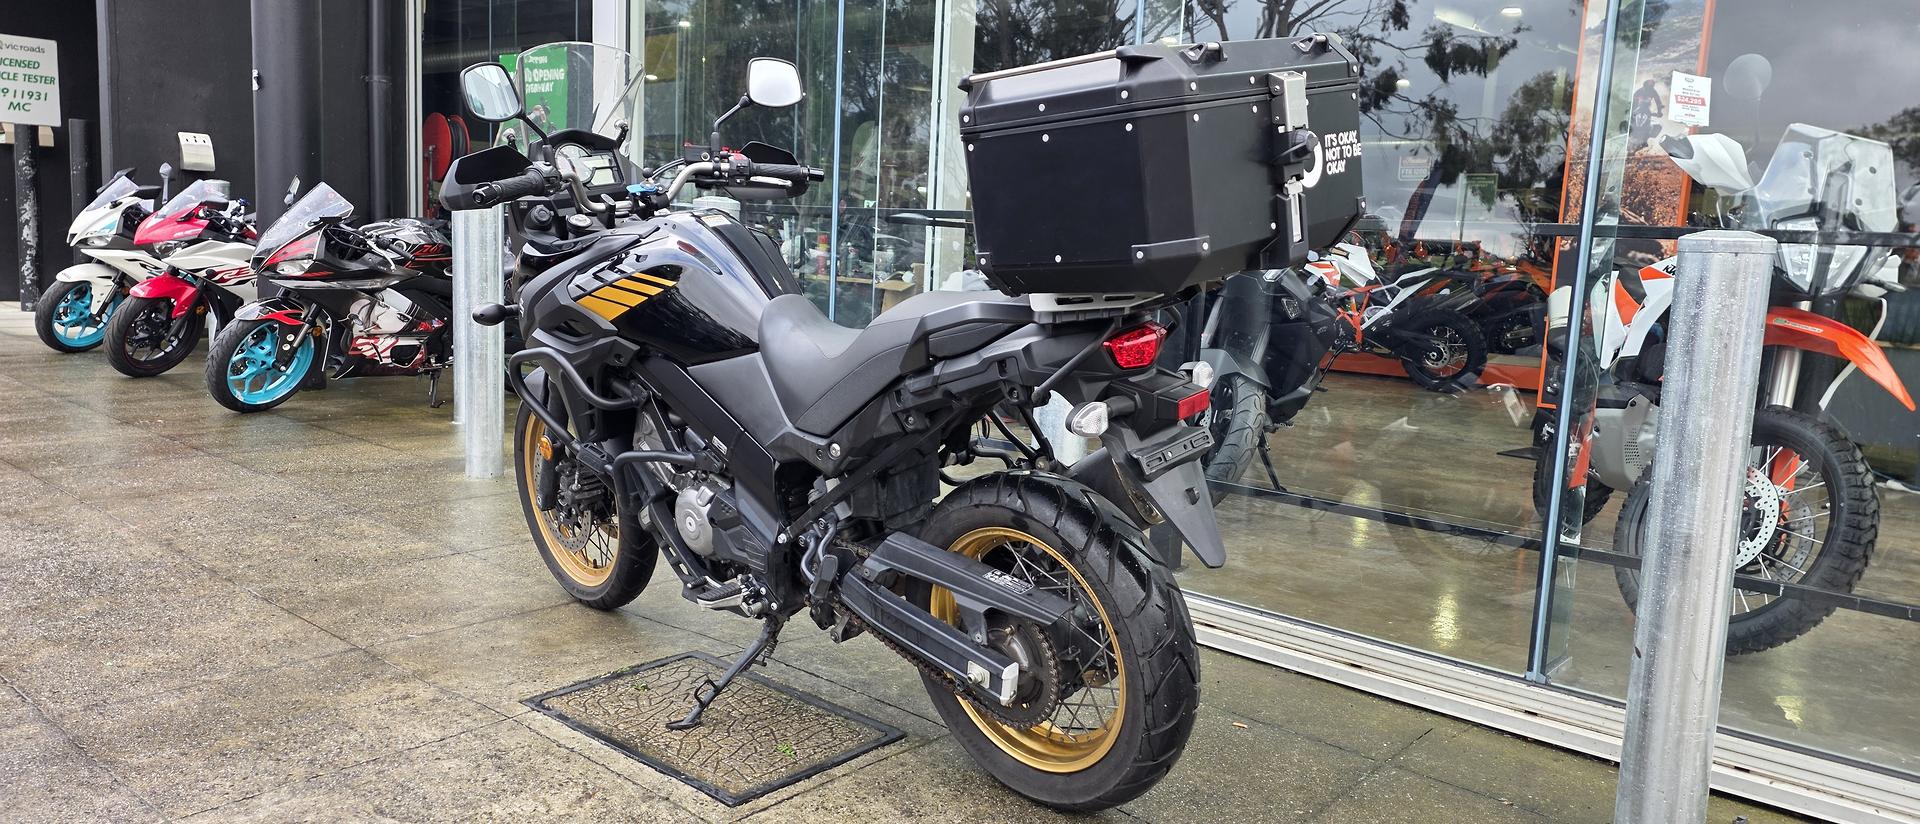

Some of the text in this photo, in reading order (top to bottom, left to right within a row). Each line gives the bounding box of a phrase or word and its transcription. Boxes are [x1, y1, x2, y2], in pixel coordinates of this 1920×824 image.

[0, 57, 40, 69] ICENSED
[22, 73, 56, 85] TESTER
[7, 101, 32, 112] MC
[1325, 143, 1362, 161] NOT TO BE
[1326, 159, 1346, 175] OKAY
